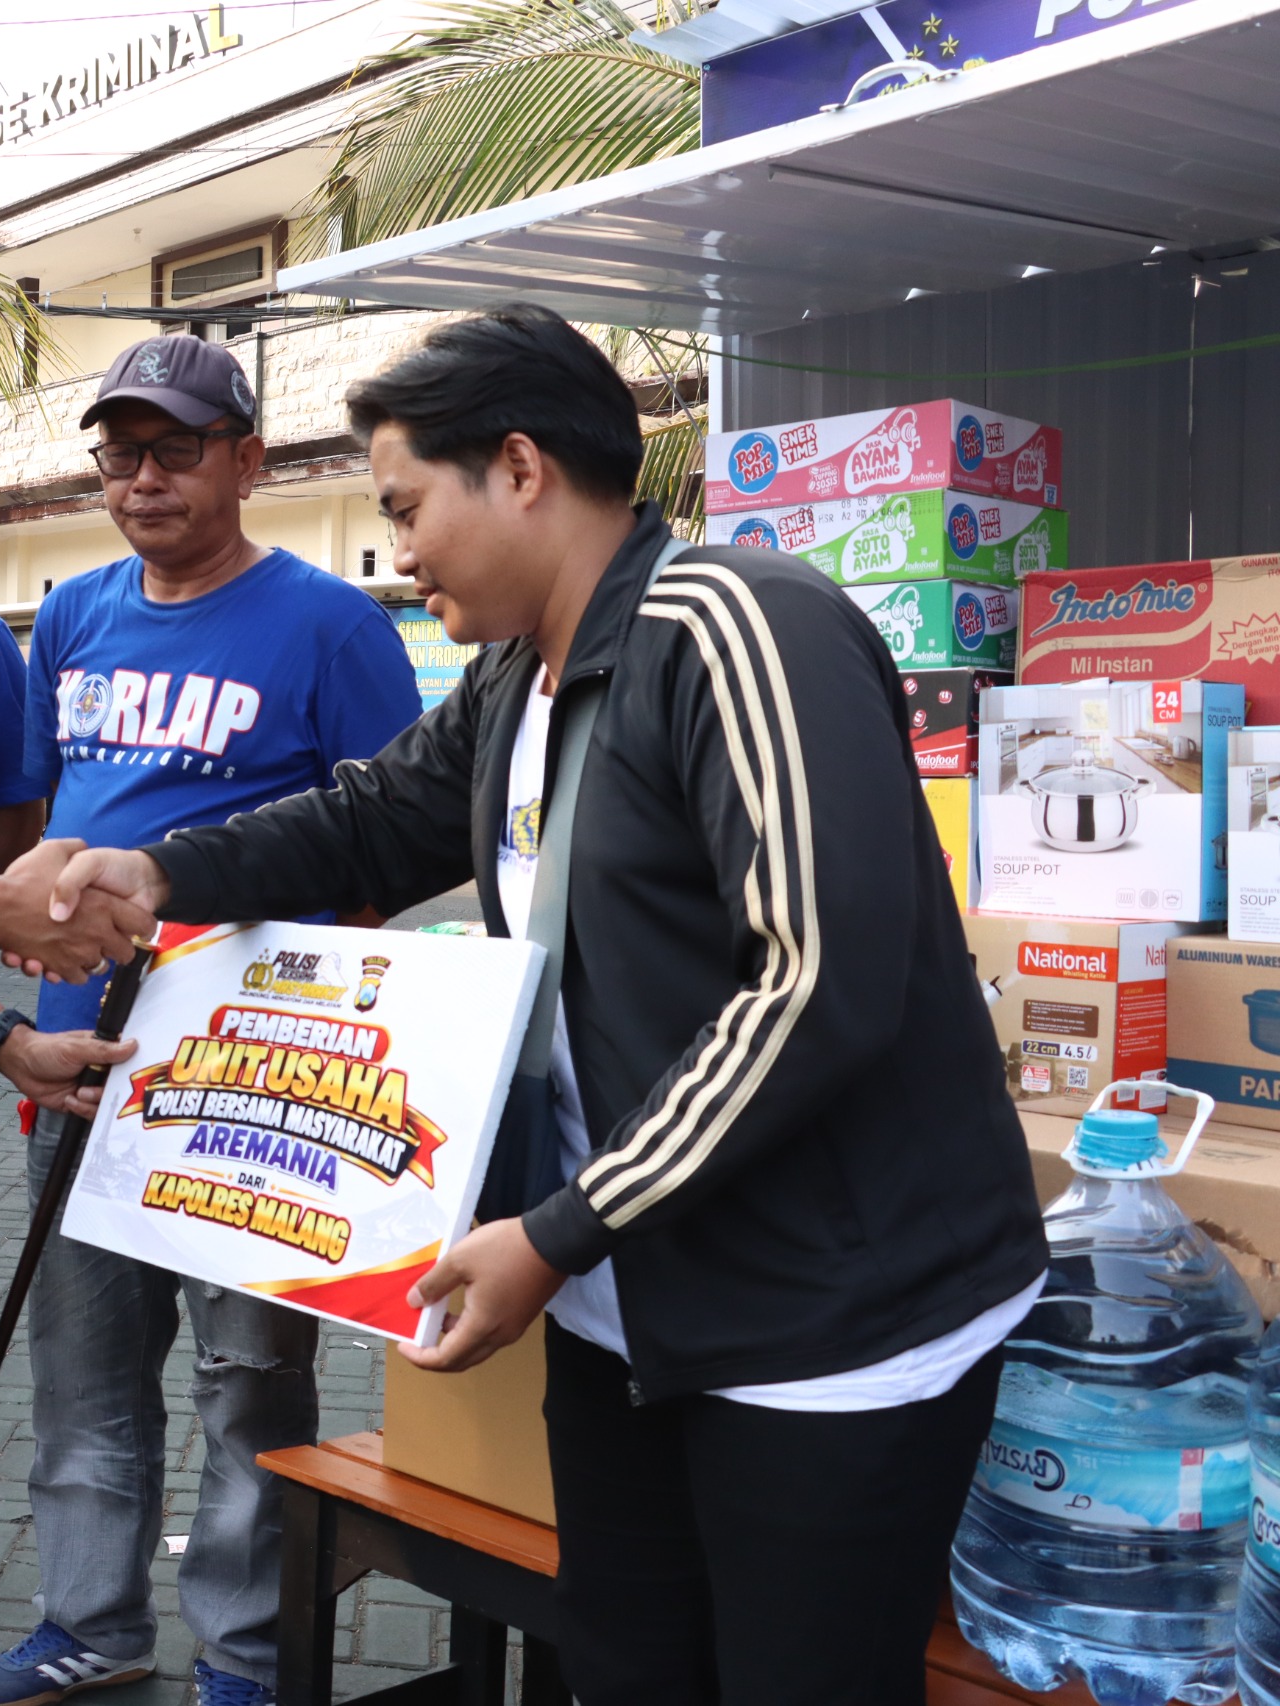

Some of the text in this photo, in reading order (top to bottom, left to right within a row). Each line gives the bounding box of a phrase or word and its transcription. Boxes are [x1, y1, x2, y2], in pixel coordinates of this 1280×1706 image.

[34, 3, 241, 128] KRIMINAL
[779, 422, 817, 449] SNEK
[960, 424, 977, 450] POP
[985, 422, 1004, 440] SNEK
[782, 440, 818, 465] TIME
[985, 438, 1005, 454] TIME
[734, 441, 764, 471] POP
[851, 444, 900, 472] AYAM
[742, 453, 775, 484] MIE
[853, 463, 901, 485] BAWANG
[910, 470, 946, 483] Indofood
[816, 475, 838, 490] SOSIS
[952, 513, 969, 537] POP
[979, 507, 1000, 525] SNEK
[781, 525, 816, 550] TIME
[957, 526, 976, 549] MIE
[981, 523, 1001, 541] TIME
[853, 537, 890, 556] SOTO
[1019, 545, 1038, 557] SOTO
[853, 551, 891, 572] AYAM
[904, 560, 939, 572] Indofood
[1241, 557, 1278, 568] GUNAKAN
[985, 595, 1006, 613] SNEK
[958, 602, 975, 625] POP
[987, 610, 1007, 628] TIME
[398, 620, 443, 642] SENTRA
[964, 614, 982, 639] MIE
[1244, 626, 1279, 639] Lengkap
[1232, 639, 1263, 650] Dengan
[1247, 645, 1280, 656] Bawang
[427, 644, 479, 668] PROPAM
[911, 650, 947, 664] Indofood
[1071, 656, 1153, 674] Mi Instan
[416, 678, 442, 688] LAYANI
[1155, 691, 1179, 708] 24
[1159, 709, 1176, 719] CM
[1207, 714, 1242, 727] SOUP POT
[993, 863, 1062, 875] SOUP POT
[1239, 894, 1277, 906] SOUP
[272, 950, 322, 970] POLISI
[1024, 946, 1107, 973] National
[1145, 944, 1167, 966] Nati
[1176, 949, 1243, 965] ALUMINIUM
[1062, 969, 1107, 980] Whistling Kettle
[219, 1009, 379, 1061] PEMBERIAN
[1026, 1041, 1040, 1052] 22
[1040, 1044, 1058, 1055] cm
[1064, 1046, 1084, 1059] 4.5
[170, 1037, 409, 1131] UNIT USAHA
[147, 1090, 406, 1173] POLISI BERSAMA MASYARAKAT
[184, 1124, 341, 1191] AREMANIA
[237, 1172, 267, 1190] DARI
[143, 1171, 351, 1262] KAPOLRES MALANG
